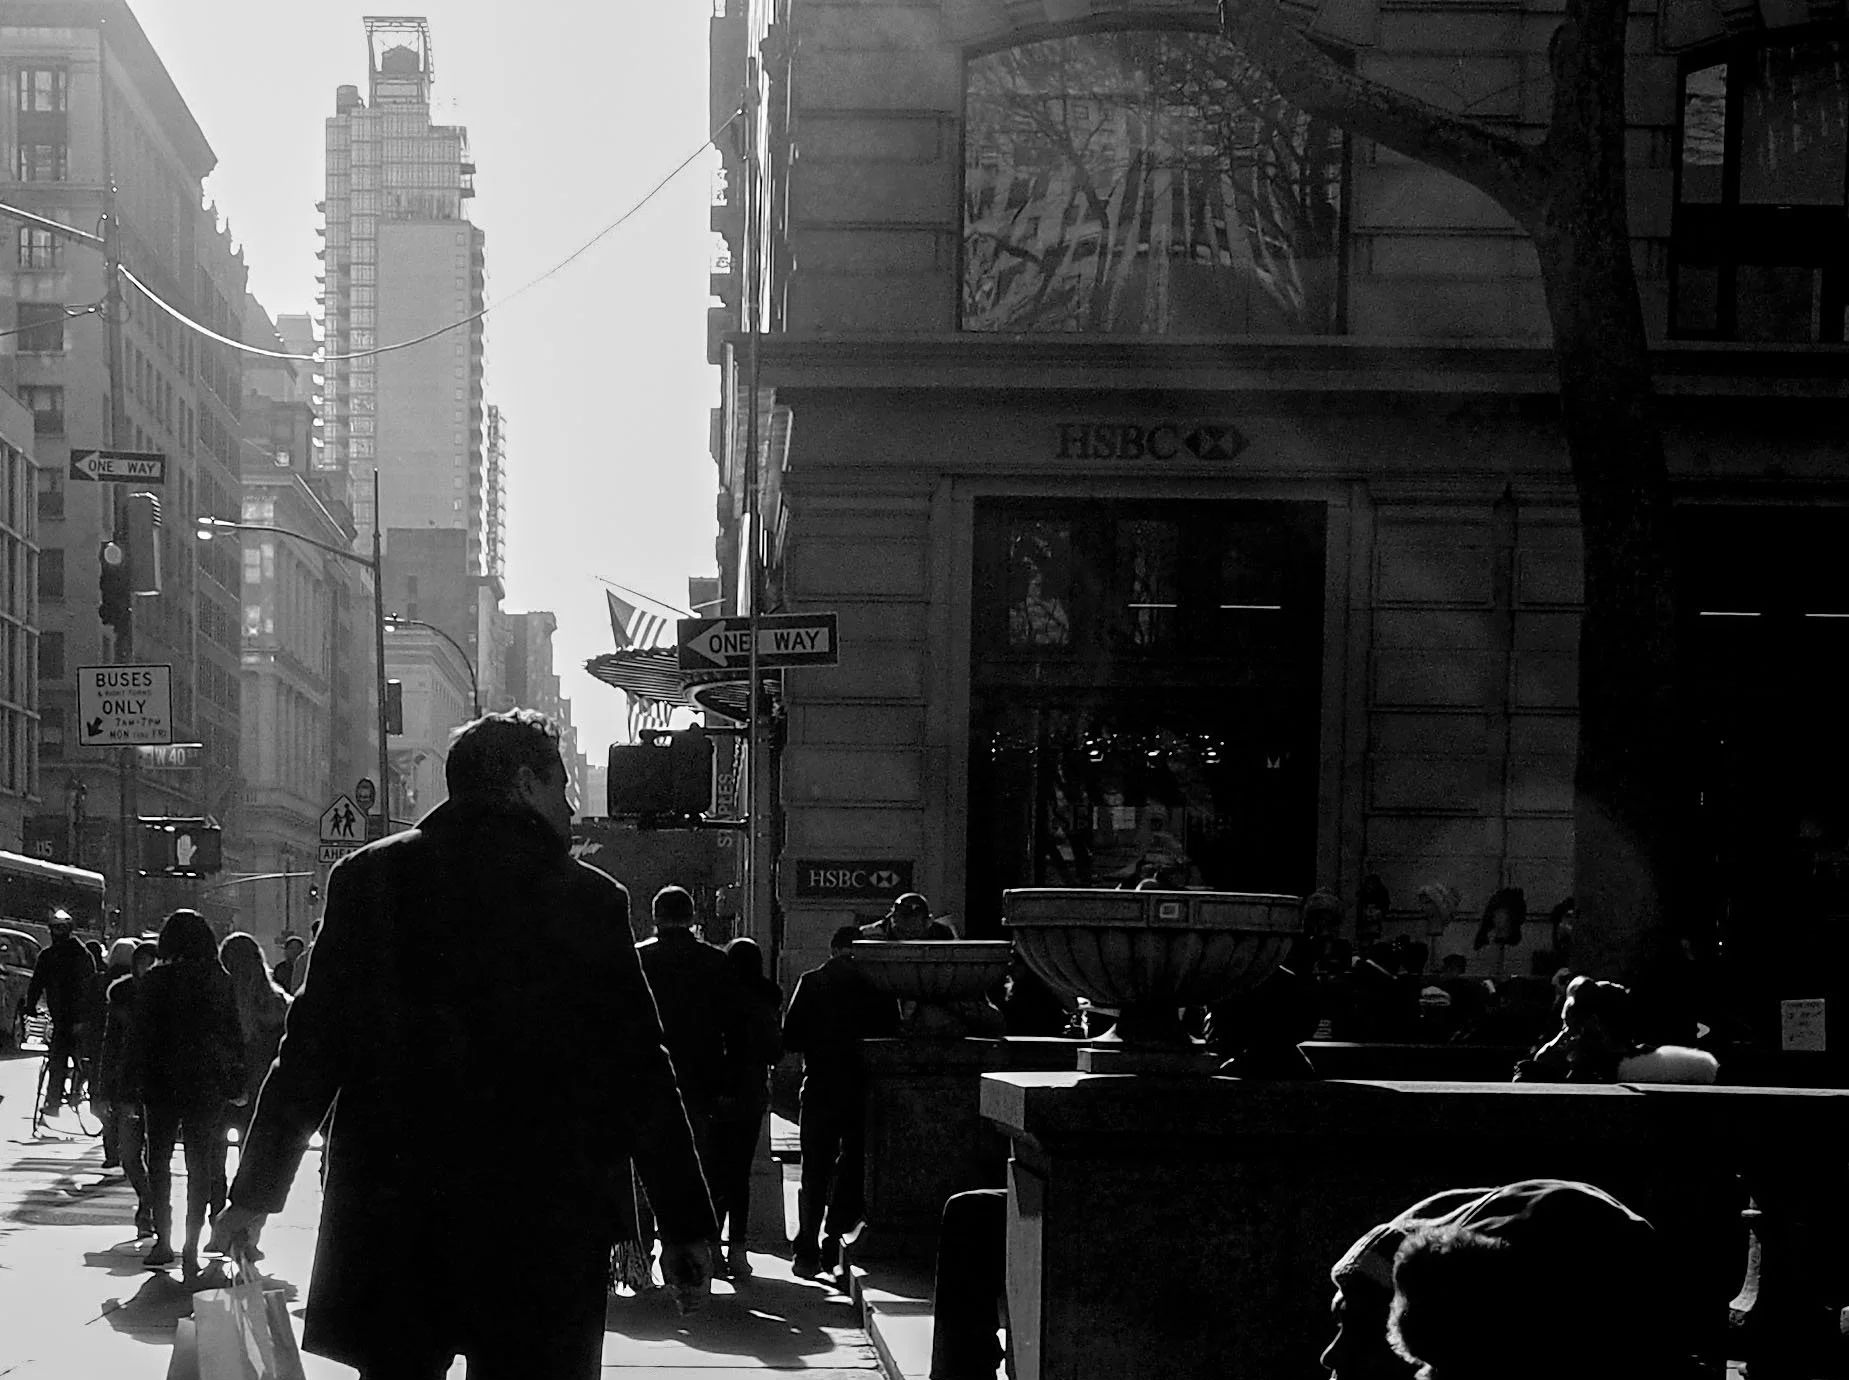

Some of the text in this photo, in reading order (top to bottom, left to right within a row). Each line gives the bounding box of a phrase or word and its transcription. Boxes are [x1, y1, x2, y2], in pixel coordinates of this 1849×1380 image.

[1056, 424, 1178, 460] HSBC
[88, 459, 157, 475] ONE WAY
[709, 630, 819, 653] ONE WAY
[96, 672, 152, 687] BUSES
[102, 700, 146, 715] ONLY
[109, 730, 130, 739] MON
[152, 728, 168, 738] FRI
[154, 747, 166, 765] W
[168, 748, 186, 766] 40
[808, 869, 867, 888] HSBC
